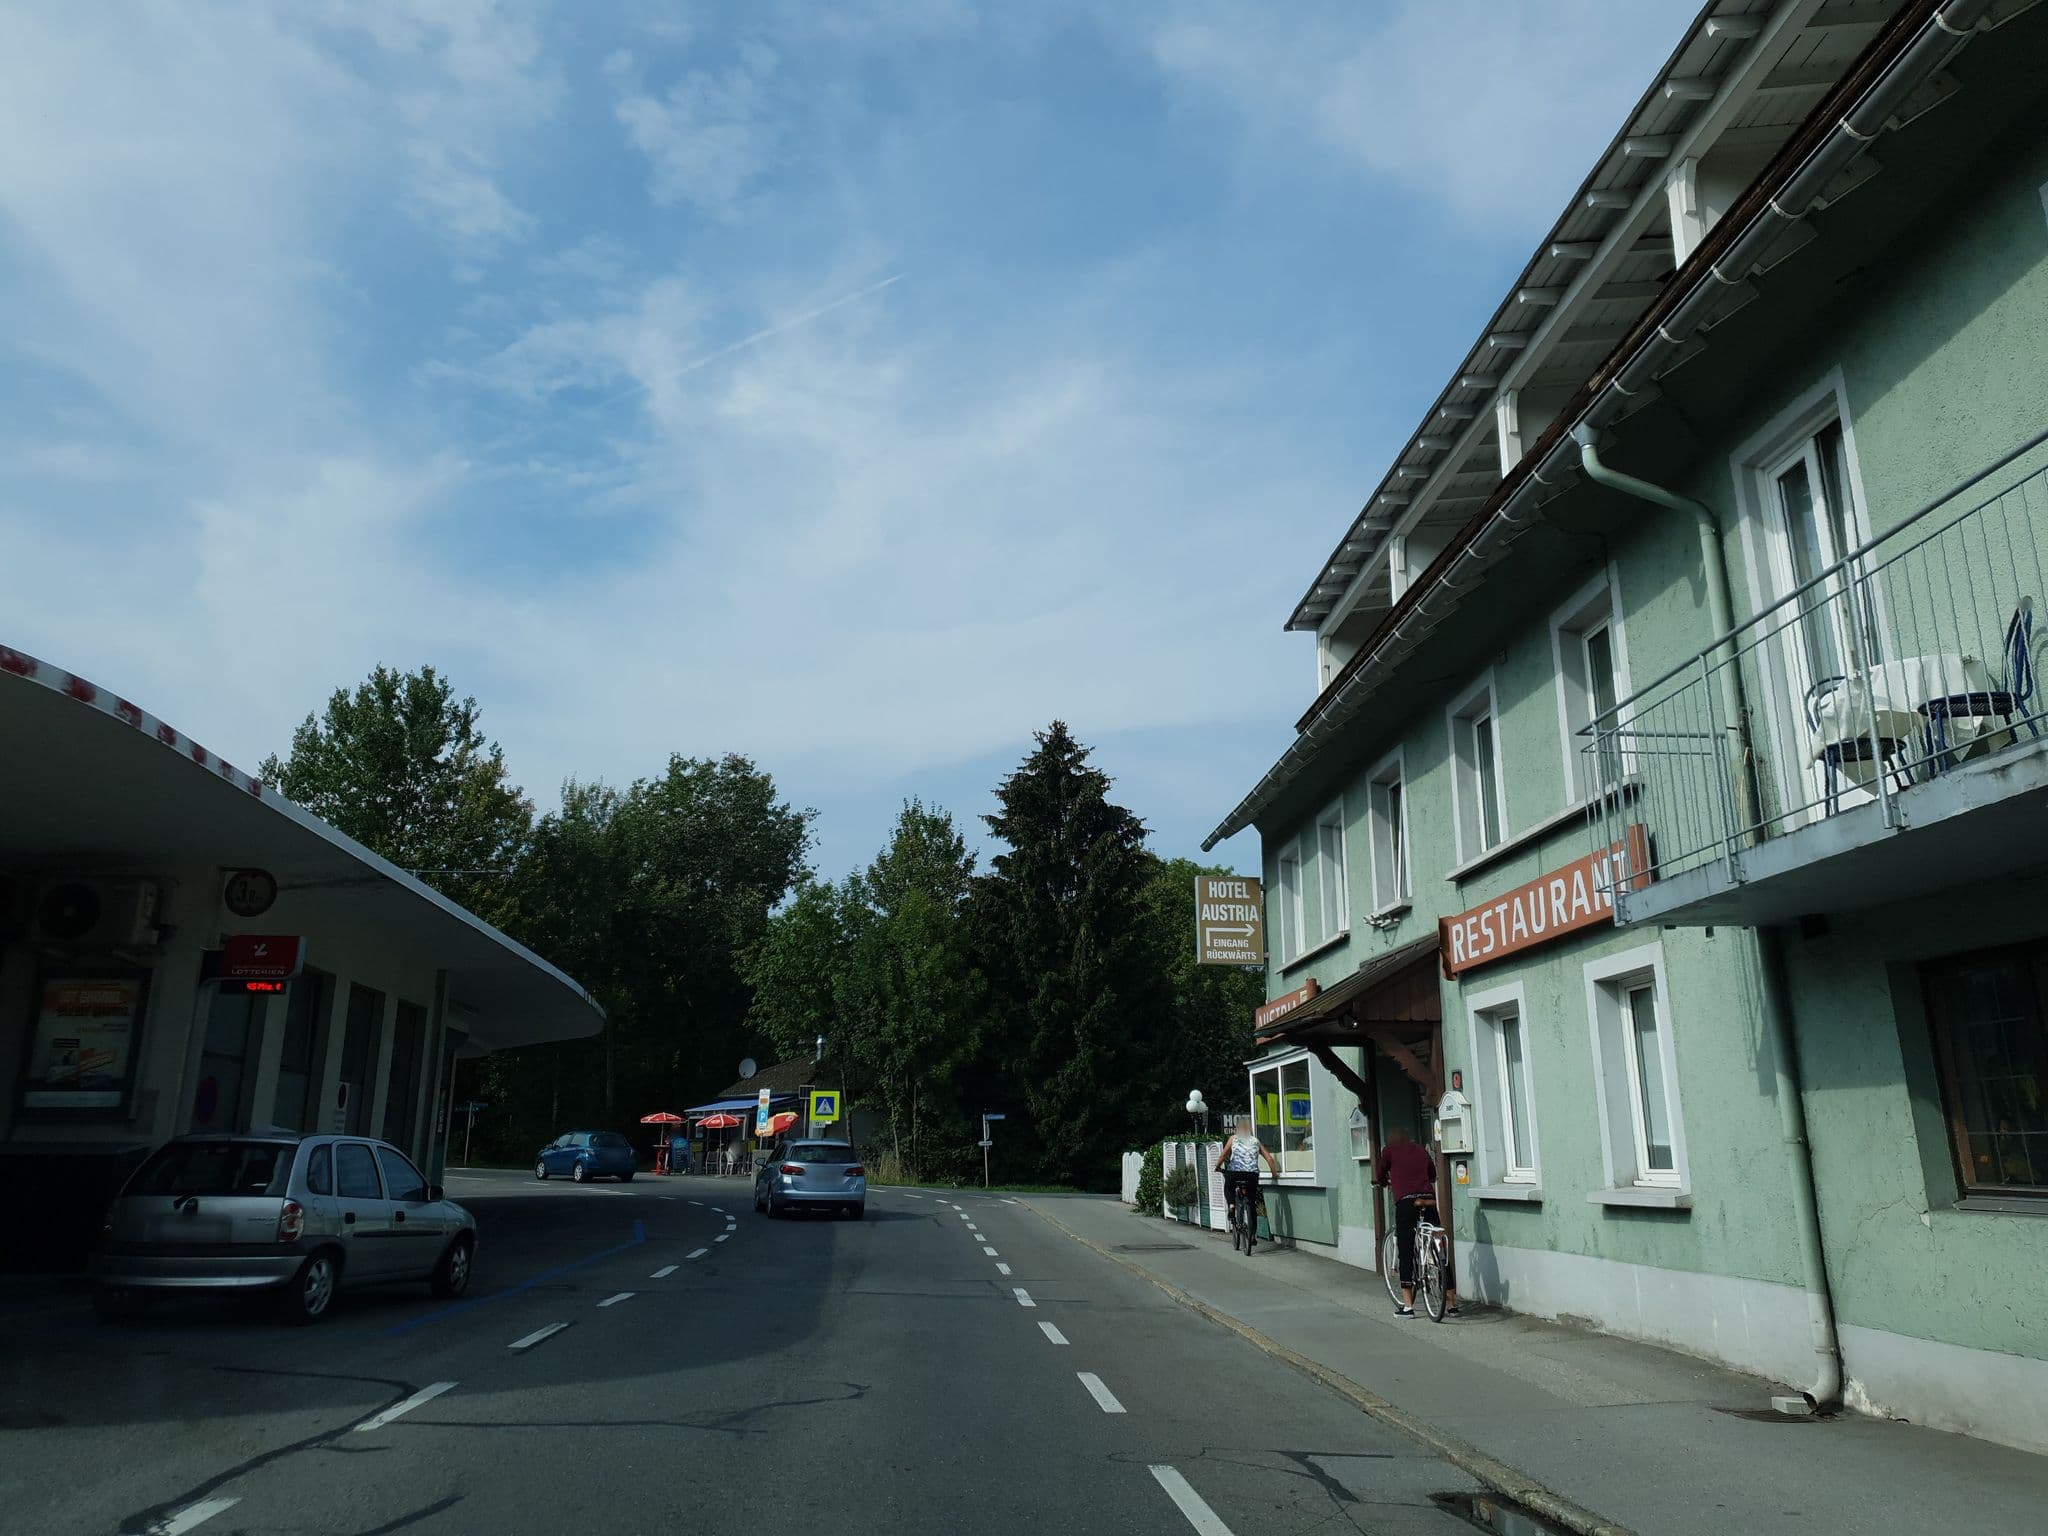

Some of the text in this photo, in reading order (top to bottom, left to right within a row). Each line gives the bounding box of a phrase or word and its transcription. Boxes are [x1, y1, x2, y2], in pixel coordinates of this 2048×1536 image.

[1208, 881, 1250, 899] HOTEL
[1201, 904, 1259, 922] AUSTRIA
[1451, 850, 1626, 964] RESTAURANT
[1213, 938, 1249, 948] EINGANG
[1206, 949, 1257, 960] RÜCKWÄRTS
